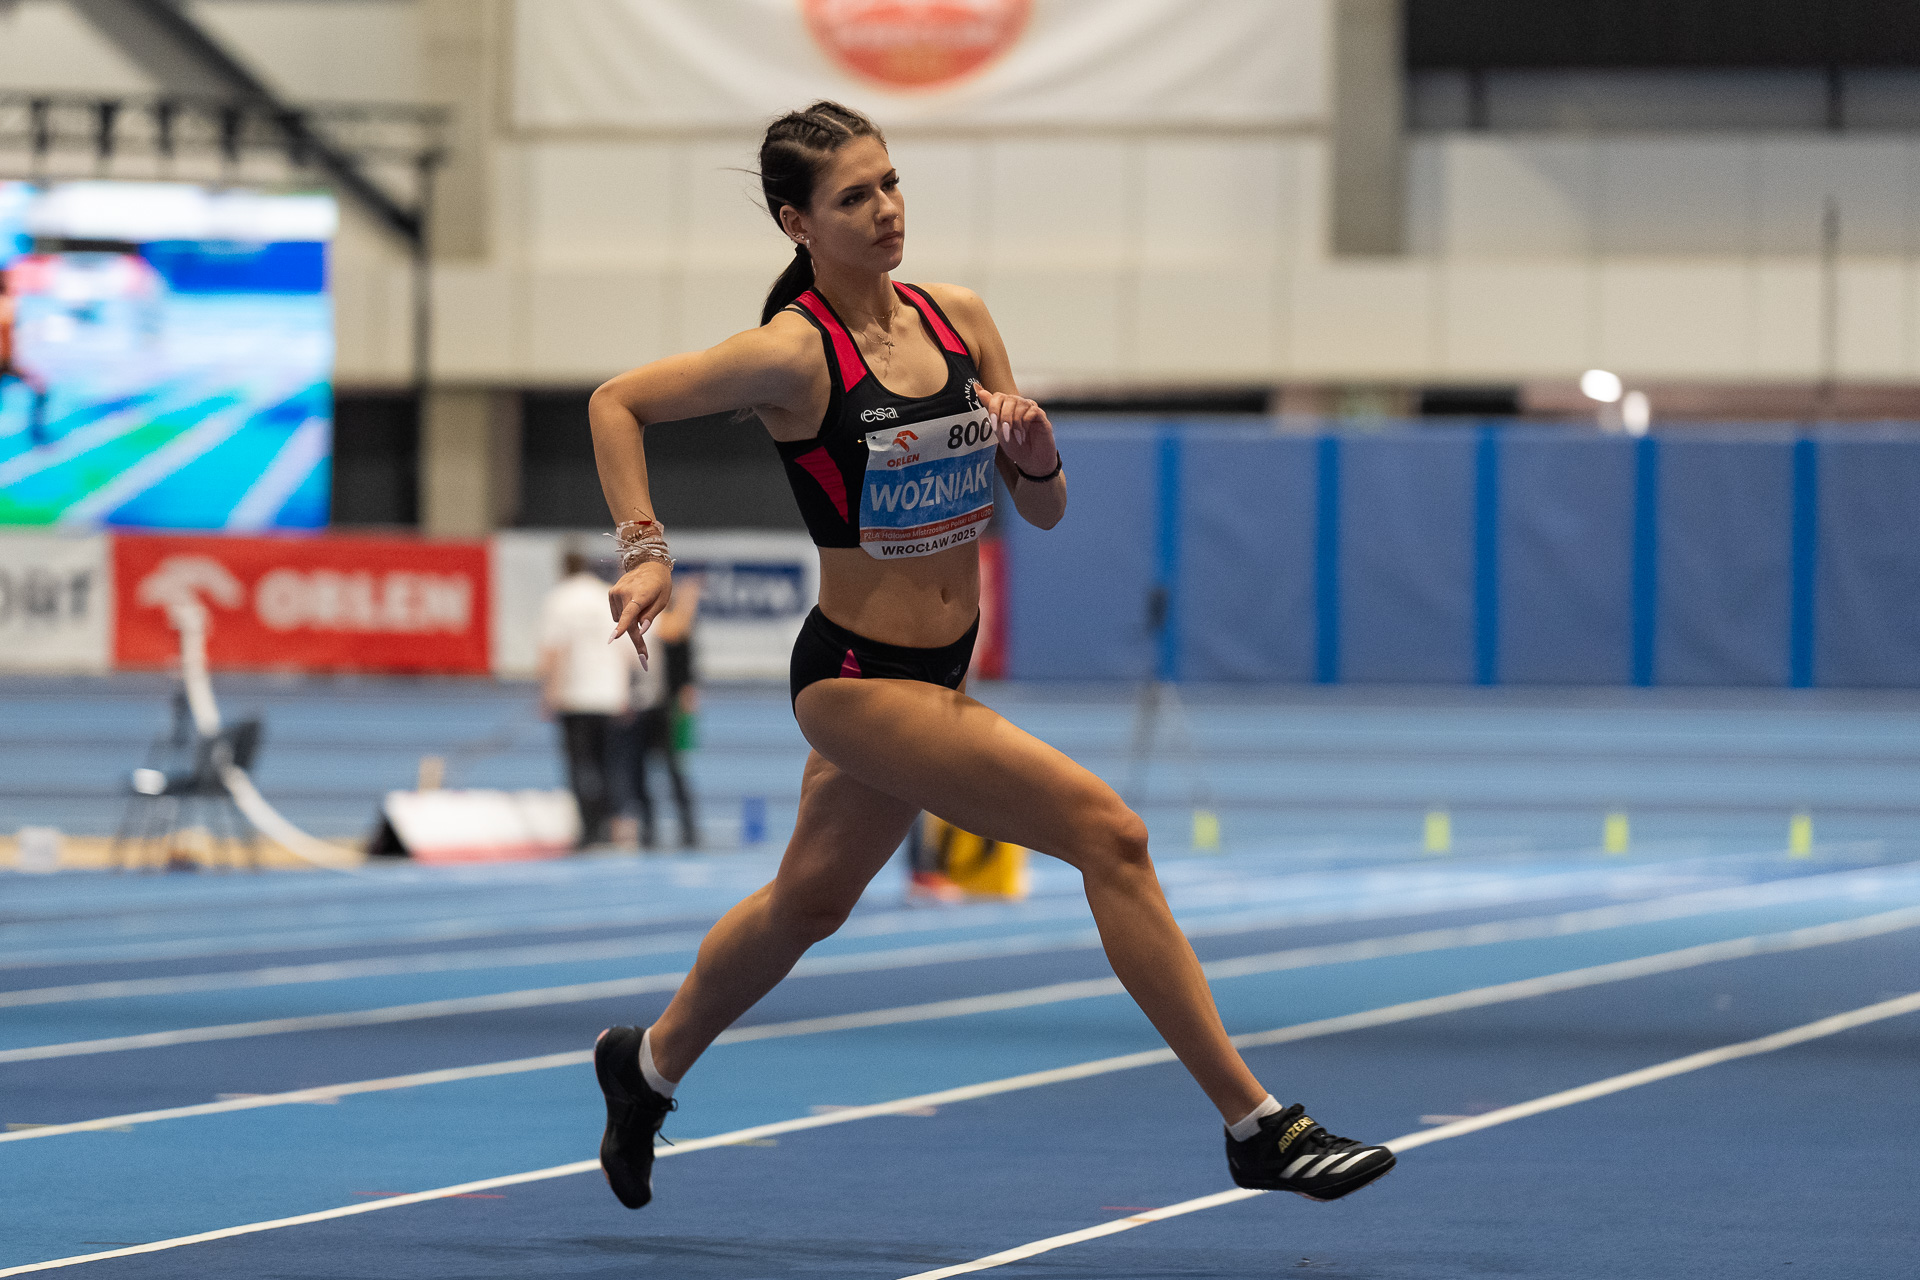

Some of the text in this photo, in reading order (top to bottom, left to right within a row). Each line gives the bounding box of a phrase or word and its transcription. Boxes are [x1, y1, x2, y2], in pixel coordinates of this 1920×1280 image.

[861, 407, 899, 423] esa
[947, 417, 992, 450] 800
[887, 453, 920, 468] ORLEN
[870, 460, 989, 513] WOŹNIAK
[864, 532, 880, 540] PZLA
[882, 531, 911, 540] Halowe
[912, 524, 950, 538] Mistrzostwa
[950, 517, 967, 528] Polski
[882, 527, 977, 556] WROCŁAW 2025
[256, 569, 473, 634] ORLEN
[1278, 1116, 1315, 1153] ADIZERO
